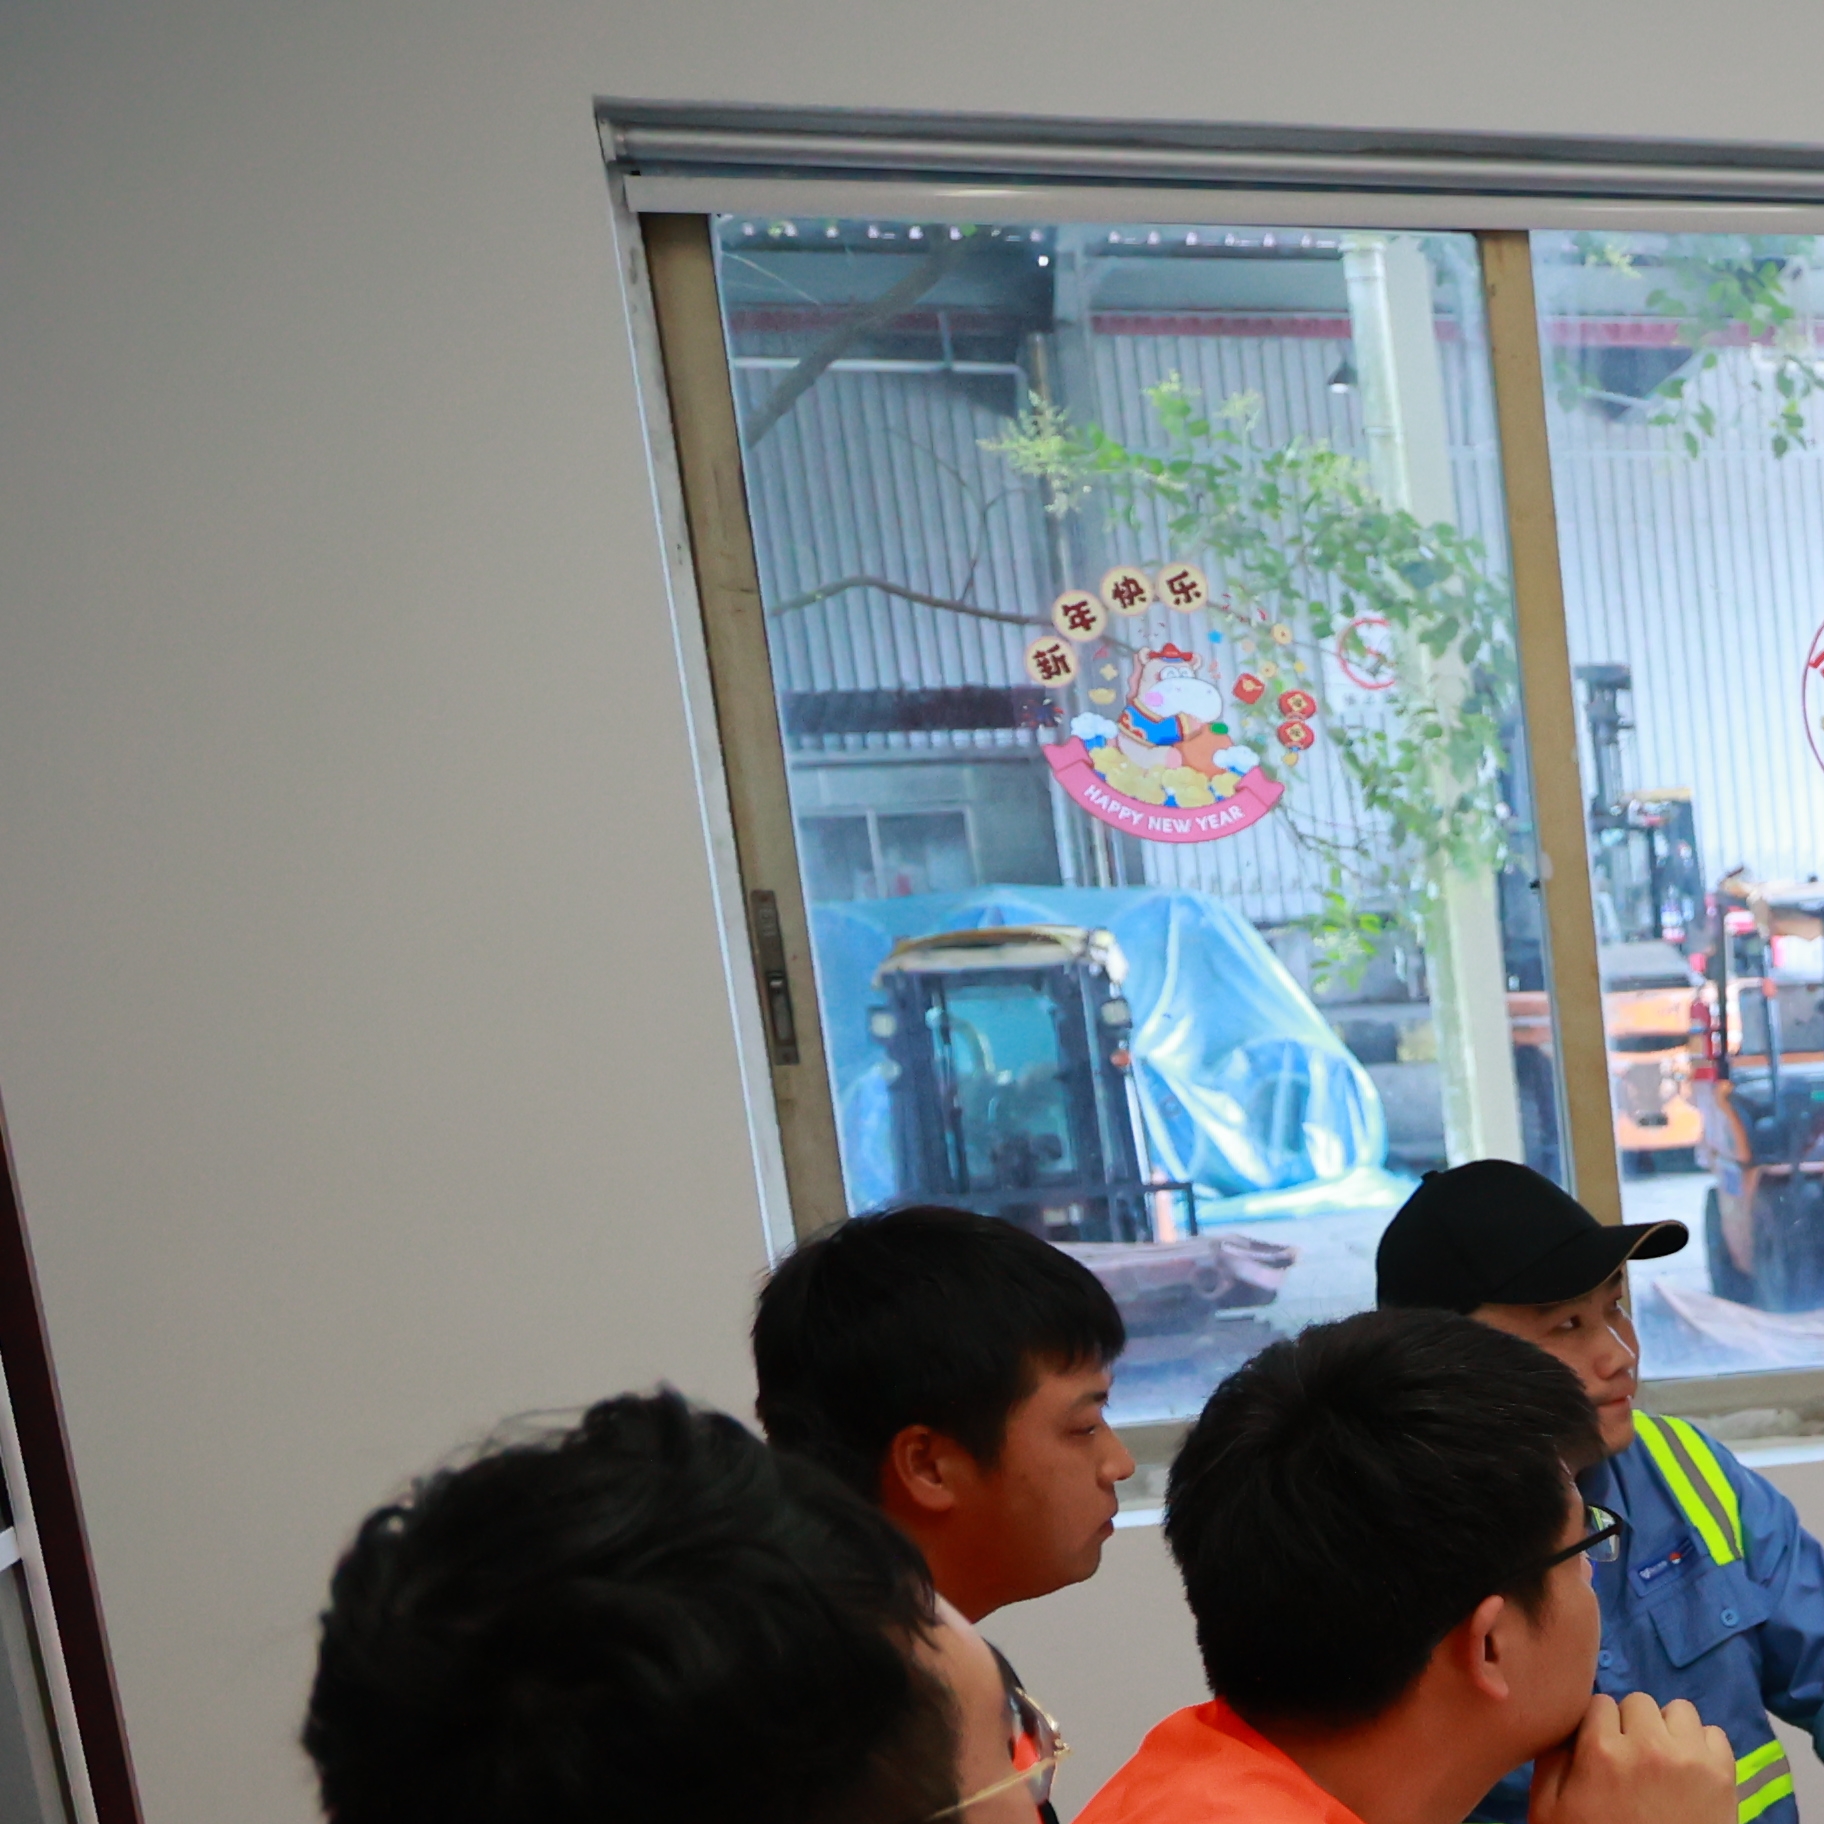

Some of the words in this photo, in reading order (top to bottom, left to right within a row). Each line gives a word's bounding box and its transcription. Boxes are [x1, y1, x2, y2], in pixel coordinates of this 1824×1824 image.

[1034, 570, 1202, 681] 新年快乐
[1083, 784, 1143, 827] HAPPY
[1147, 814, 1192, 834] NEW
[1195, 806, 1246, 832] YEAR
